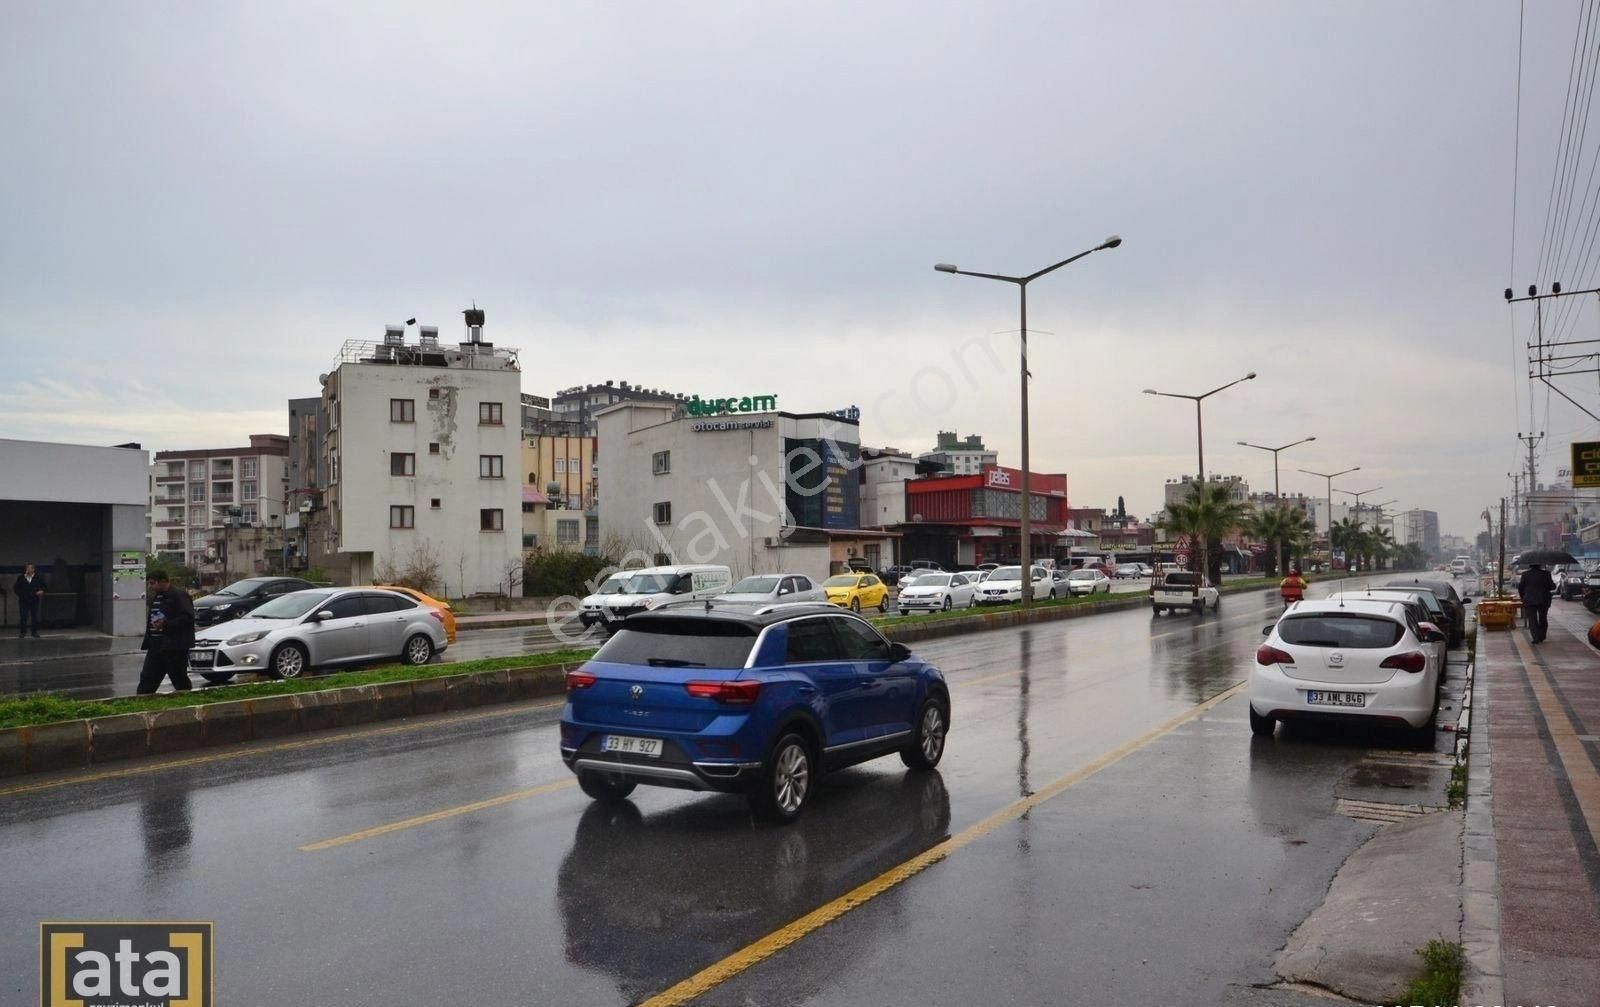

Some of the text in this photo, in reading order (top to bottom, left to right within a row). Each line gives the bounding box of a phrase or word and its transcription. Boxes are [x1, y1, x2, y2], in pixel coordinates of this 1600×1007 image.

[687, 394, 776, 416] durcam
[693, 420, 738, 431] otocam
[1314, 692, 1362, 704] 33 ANL 846
[608, 737, 619, 749] 33
[639, 740, 657, 753] 927
